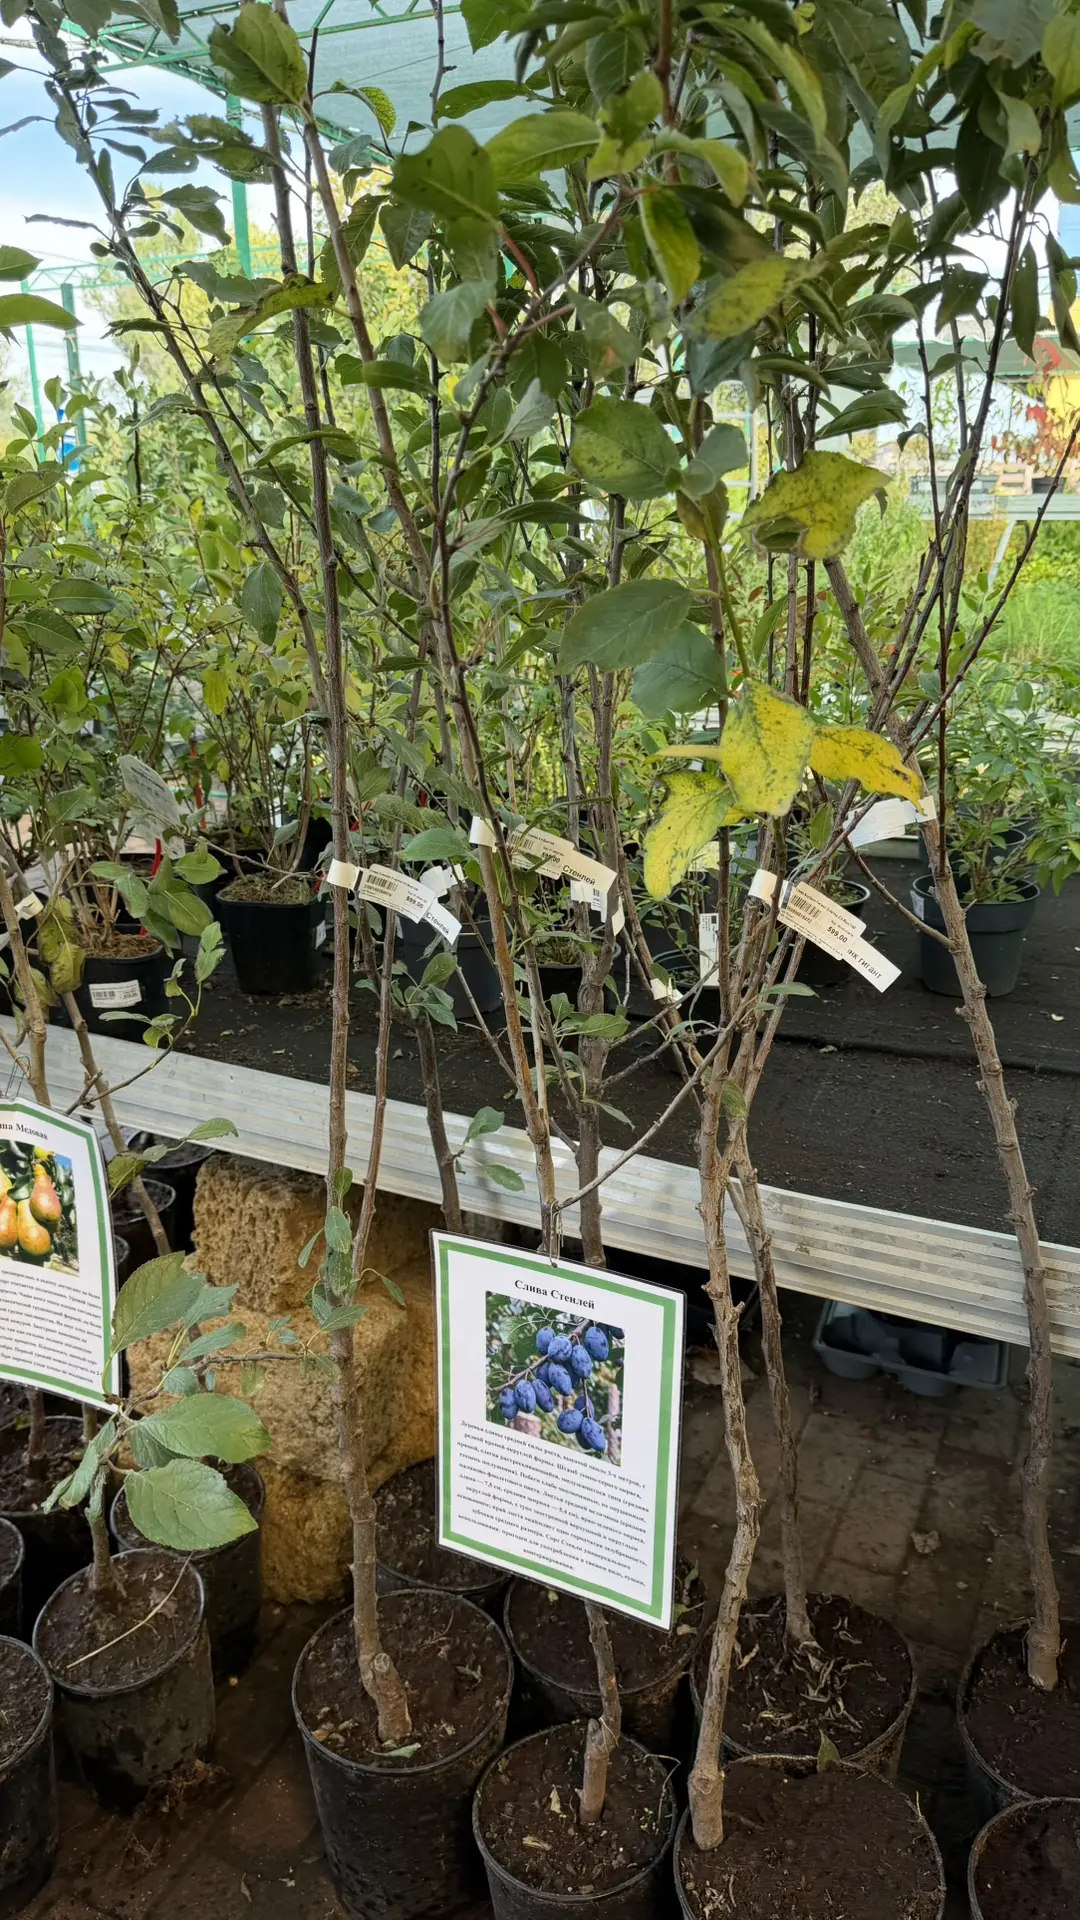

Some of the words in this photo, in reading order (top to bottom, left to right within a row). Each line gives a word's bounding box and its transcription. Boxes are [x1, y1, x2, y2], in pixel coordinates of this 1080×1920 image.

[563, 864, 595, 885] Стенлей
[426, 912, 450, 935] Стенлей
[825, 925, 849, 943] 599,00
[857, 957, 882, 979] гигант
[16, 1123, 48, 1140] Медовая
[514, 1279, 548, 1296] Слива
[550, 1289, 595, 1309] Стенлей
